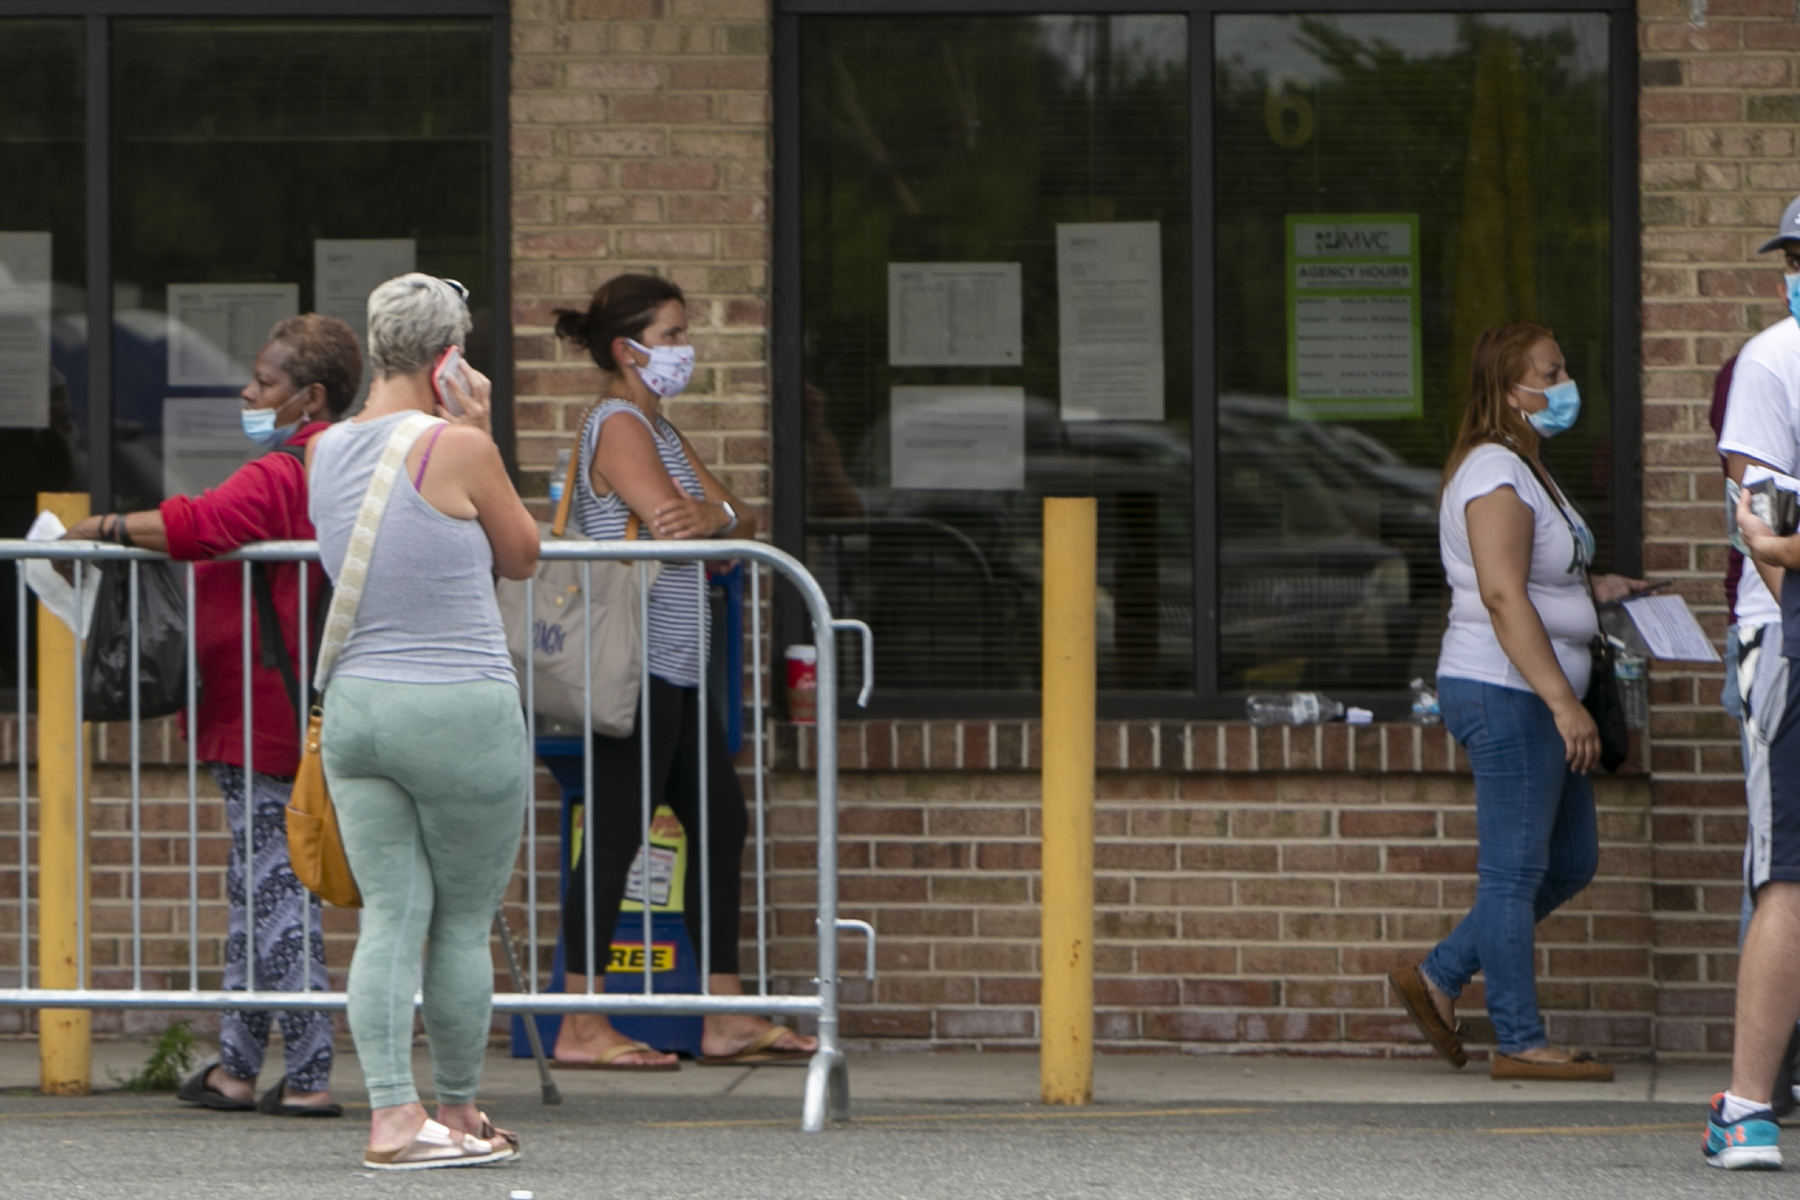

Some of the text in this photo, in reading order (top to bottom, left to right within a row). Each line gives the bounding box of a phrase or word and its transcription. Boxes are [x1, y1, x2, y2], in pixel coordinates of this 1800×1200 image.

[1298, 266, 1409, 278] AGENCY HOURS
[609, 949, 667, 968] REE
